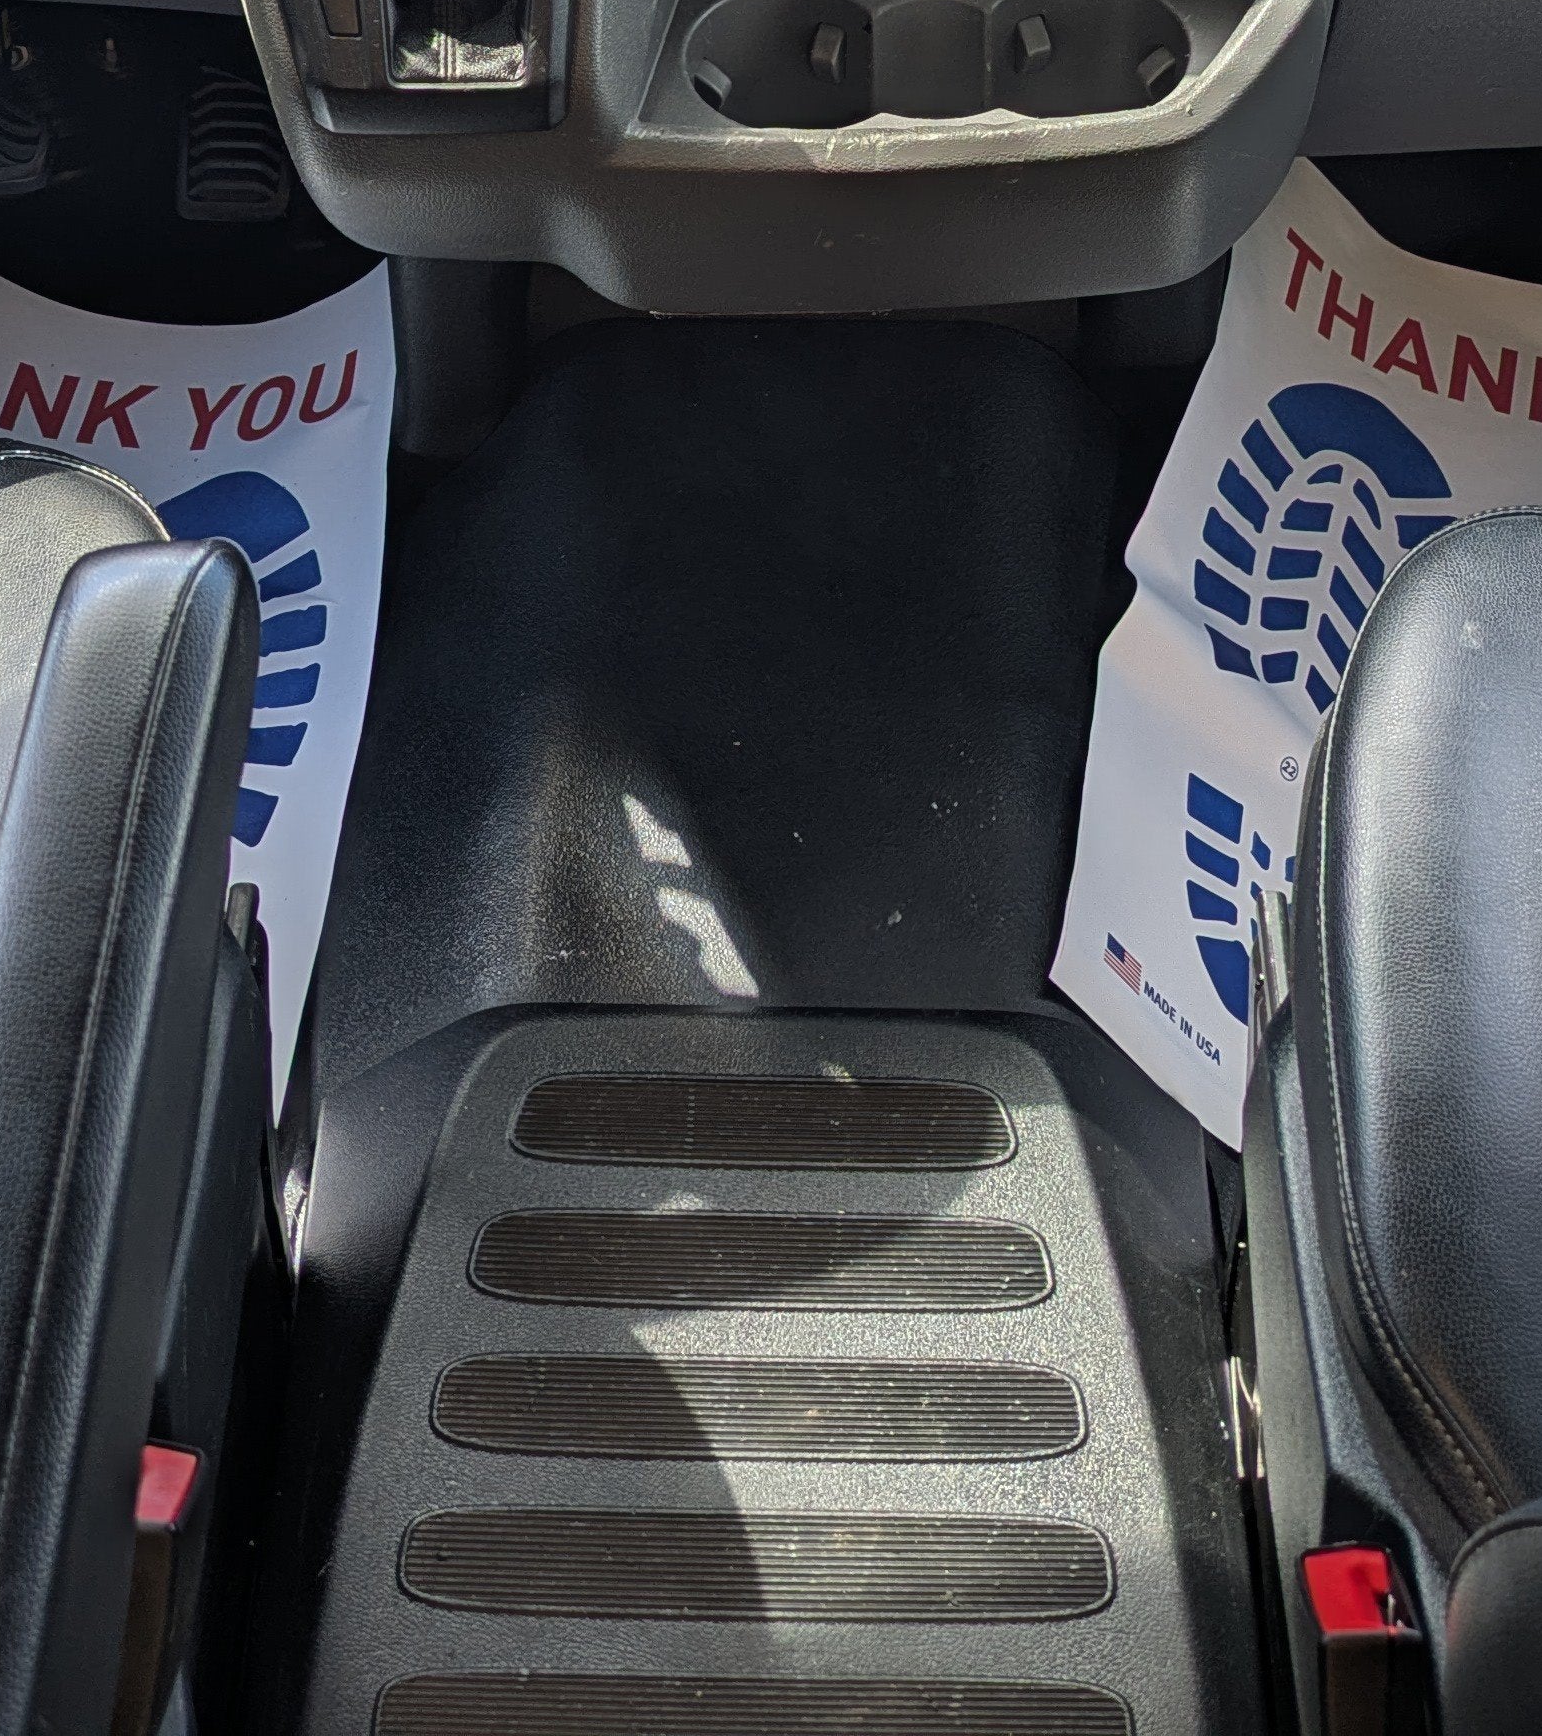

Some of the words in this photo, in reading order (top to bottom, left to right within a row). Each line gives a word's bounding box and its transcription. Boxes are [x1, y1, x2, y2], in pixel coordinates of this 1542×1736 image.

[187, 349, 359, 451] YOU
[1143, 981, 1177, 1024] MADE
[1180, 1016, 1193, 1040] IN
[1196, 1031, 1221, 1067] USA
